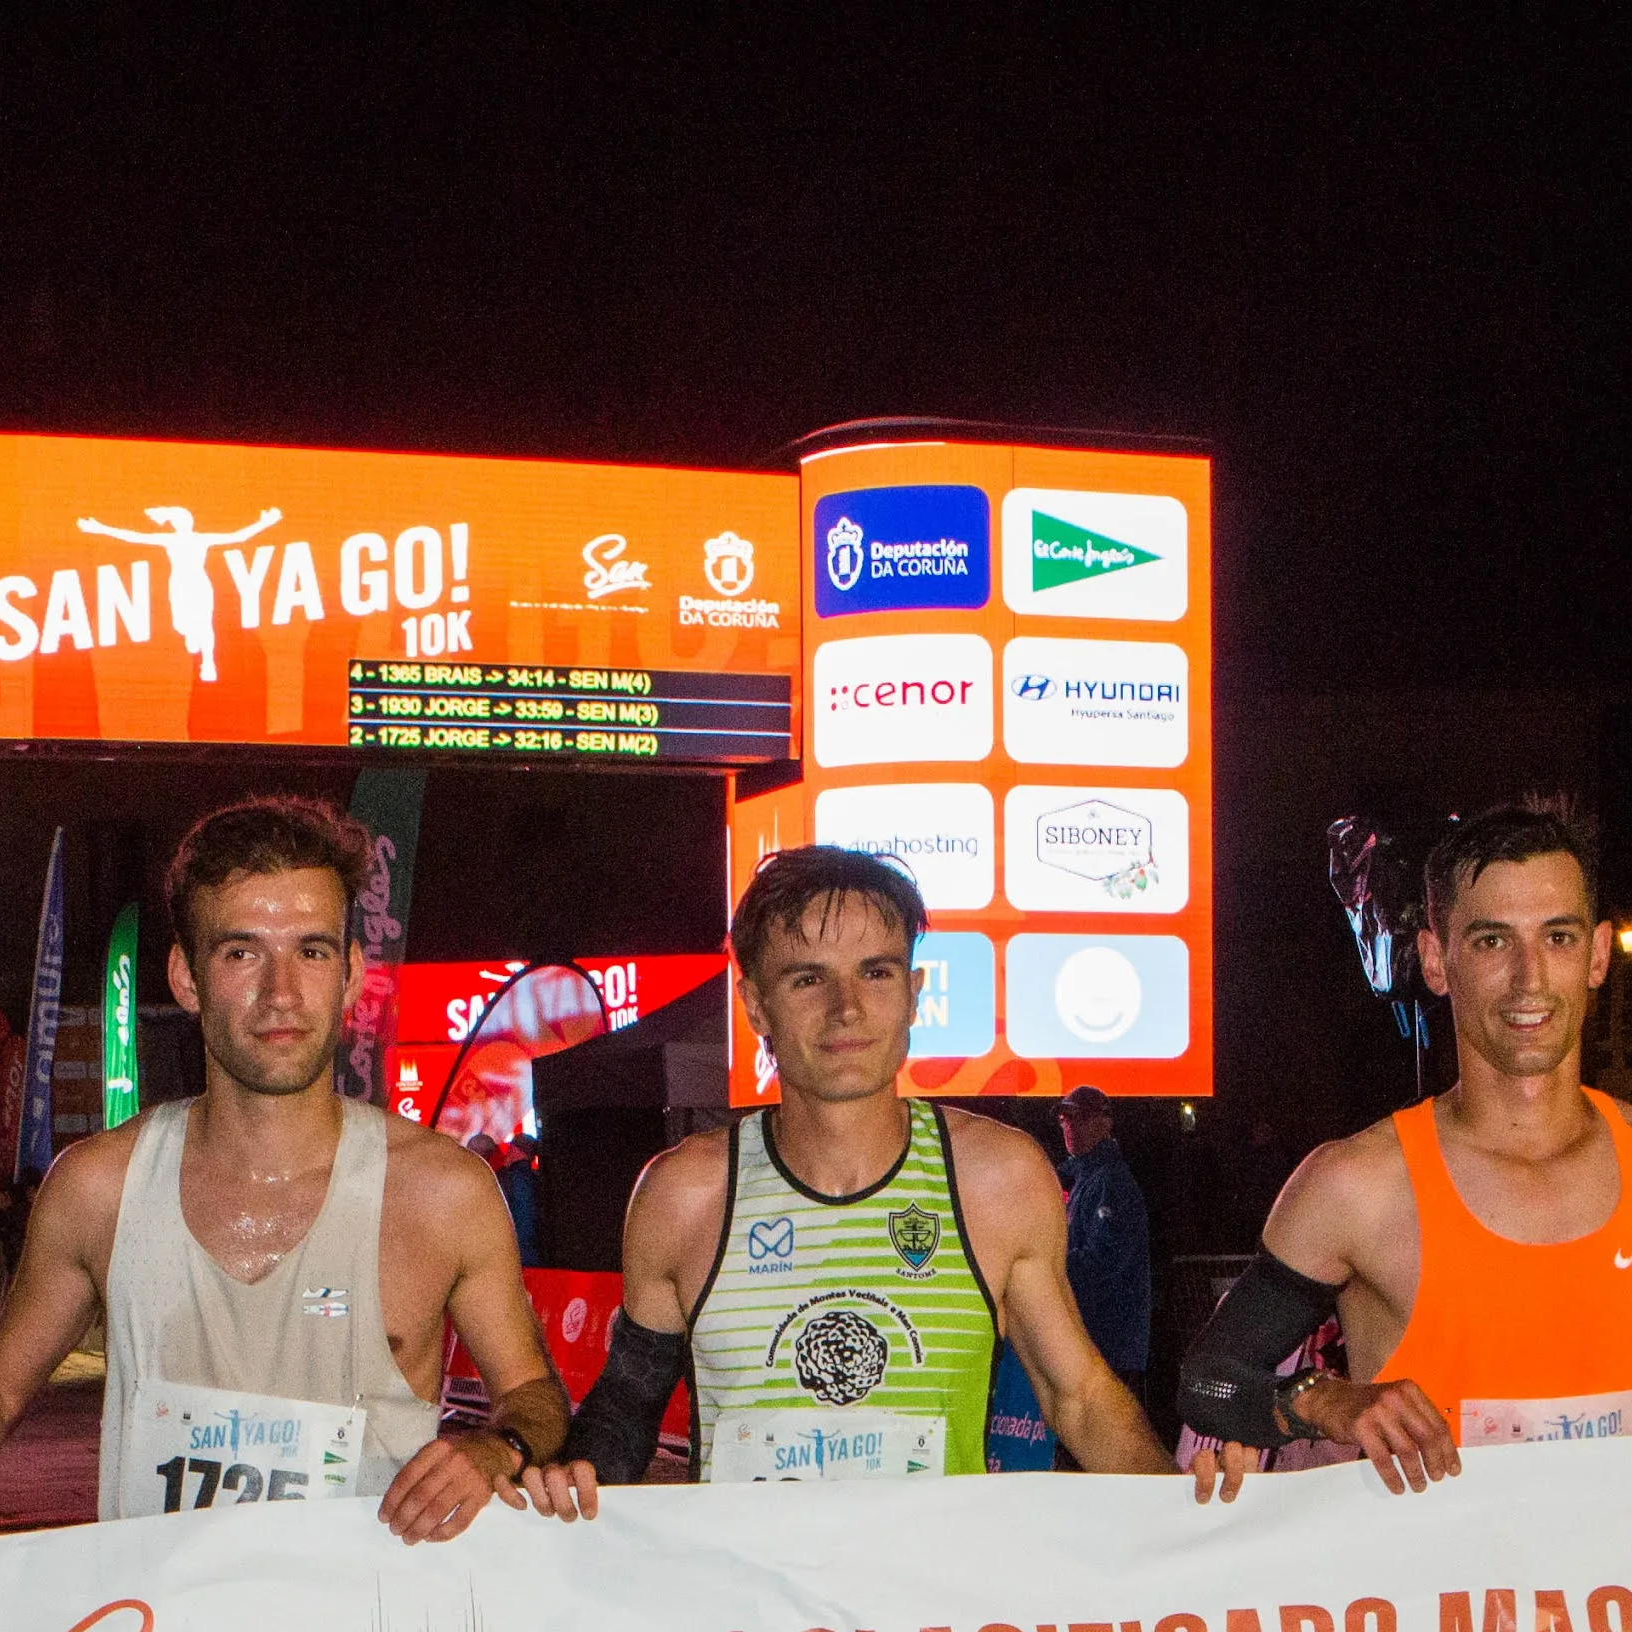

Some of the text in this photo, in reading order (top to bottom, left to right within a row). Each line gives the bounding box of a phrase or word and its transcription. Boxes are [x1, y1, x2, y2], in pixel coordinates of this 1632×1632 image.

[870, 540, 969, 561] Deputación
[224, 541, 325, 628] YA
[340, 522, 469, 616] GO!
[871, 556, 969, 578] DA CORUÑA
[679, 596, 780, 615] Deputación
[679, 610, 780, 628] DA CORUÑA
[401, 611, 473, 658] 10K
[350, 664, 363, 682] 4
[379, 665, 422, 684] 1365
[424, 667, 483, 686] BRAIS
[507, 669, 555, 688] 34:14
[568, 672, 608, 690] SEN
[611, 672, 652, 695] M(4)
[1065, 680, 1180, 703] HYUNDAI
[854, 679, 974, 709] cenor
[350, 696, 363, 714] 3
[379, 697, 421, 716] 1930
[424, 698, 491, 719] JORGE
[514, 700, 564, 719] 33:59
[576, 702, 616, 721] SEN
[619, 703, 659, 726] M(3)
[350, 728, 363, 746] 2
[379, 728, 421, 746] 1725
[424, 729, 491, 749] JORGE
[514, 732, 563, 751] 32:16
[576, 733, 616, 752] SEN
[619, 733, 658, 756] M(2)
[1045, 826, 1142, 846] SIBONEY
[748, 1262, 793, 1275] MARÍN
[809, 1289, 847, 1307] Montes
[190, 1419, 301, 1449] SAN YA GO!
[1598, 1409, 1622, 1438] GO!
[775, 1432, 883, 1470] SAN YA GO!
